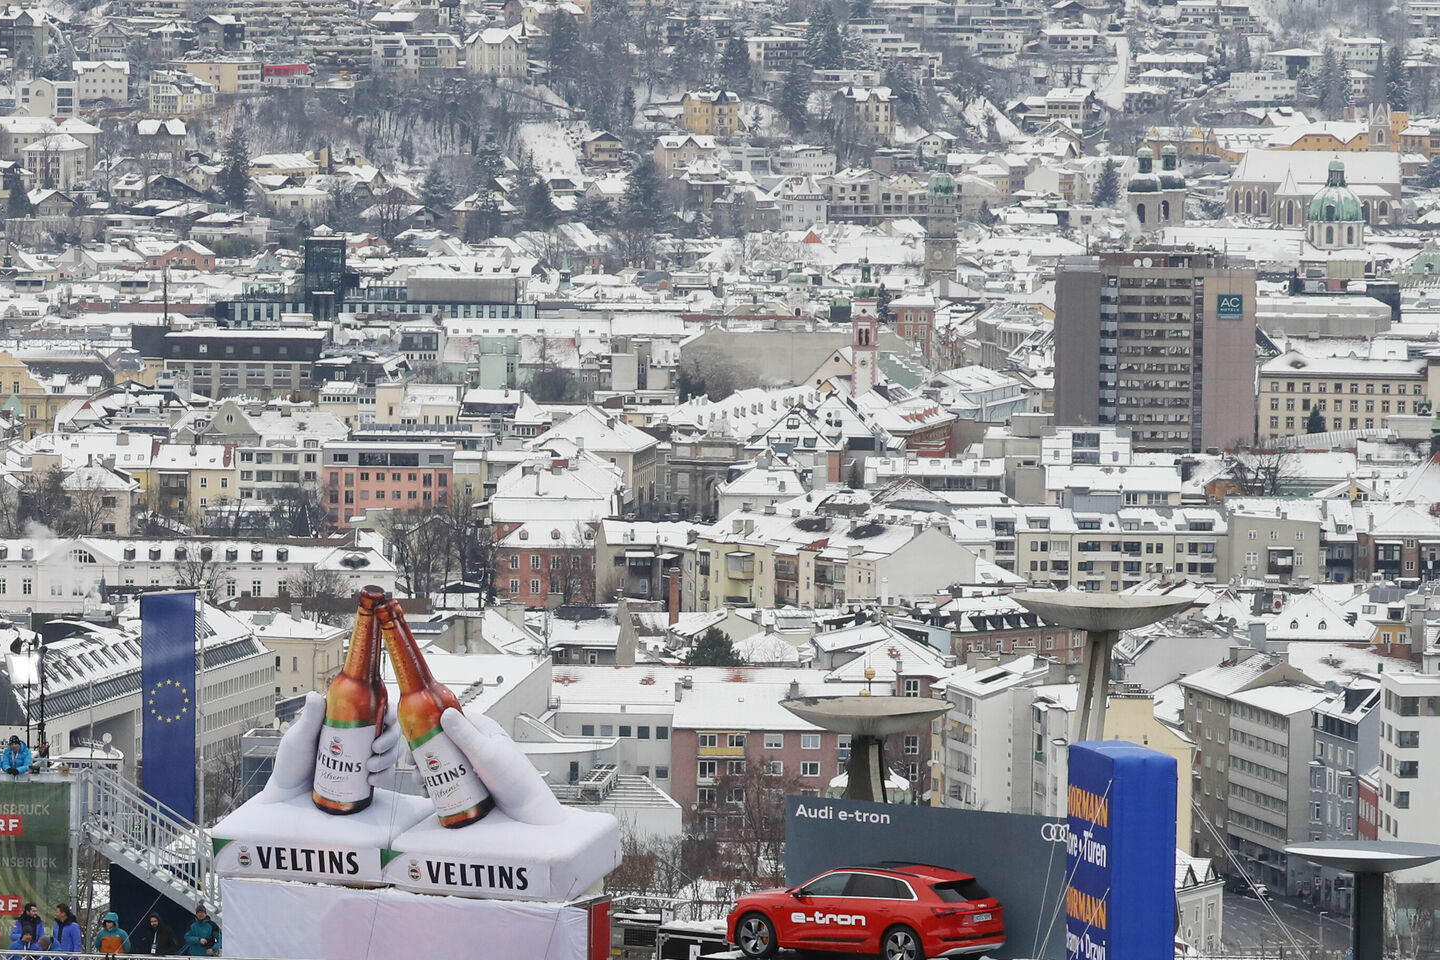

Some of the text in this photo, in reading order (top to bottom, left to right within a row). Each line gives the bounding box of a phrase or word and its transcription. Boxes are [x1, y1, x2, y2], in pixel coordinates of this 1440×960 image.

[1221, 297, 1240, 307] AC
[796, 804, 890, 824] Audi e-tron
[256, 846, 359, 875] VELTINS
[1083, 830, 1106, 867] Türen
[426, 860, 529, 891] VELTINS
[790, 911, 866, 926] e-tron
